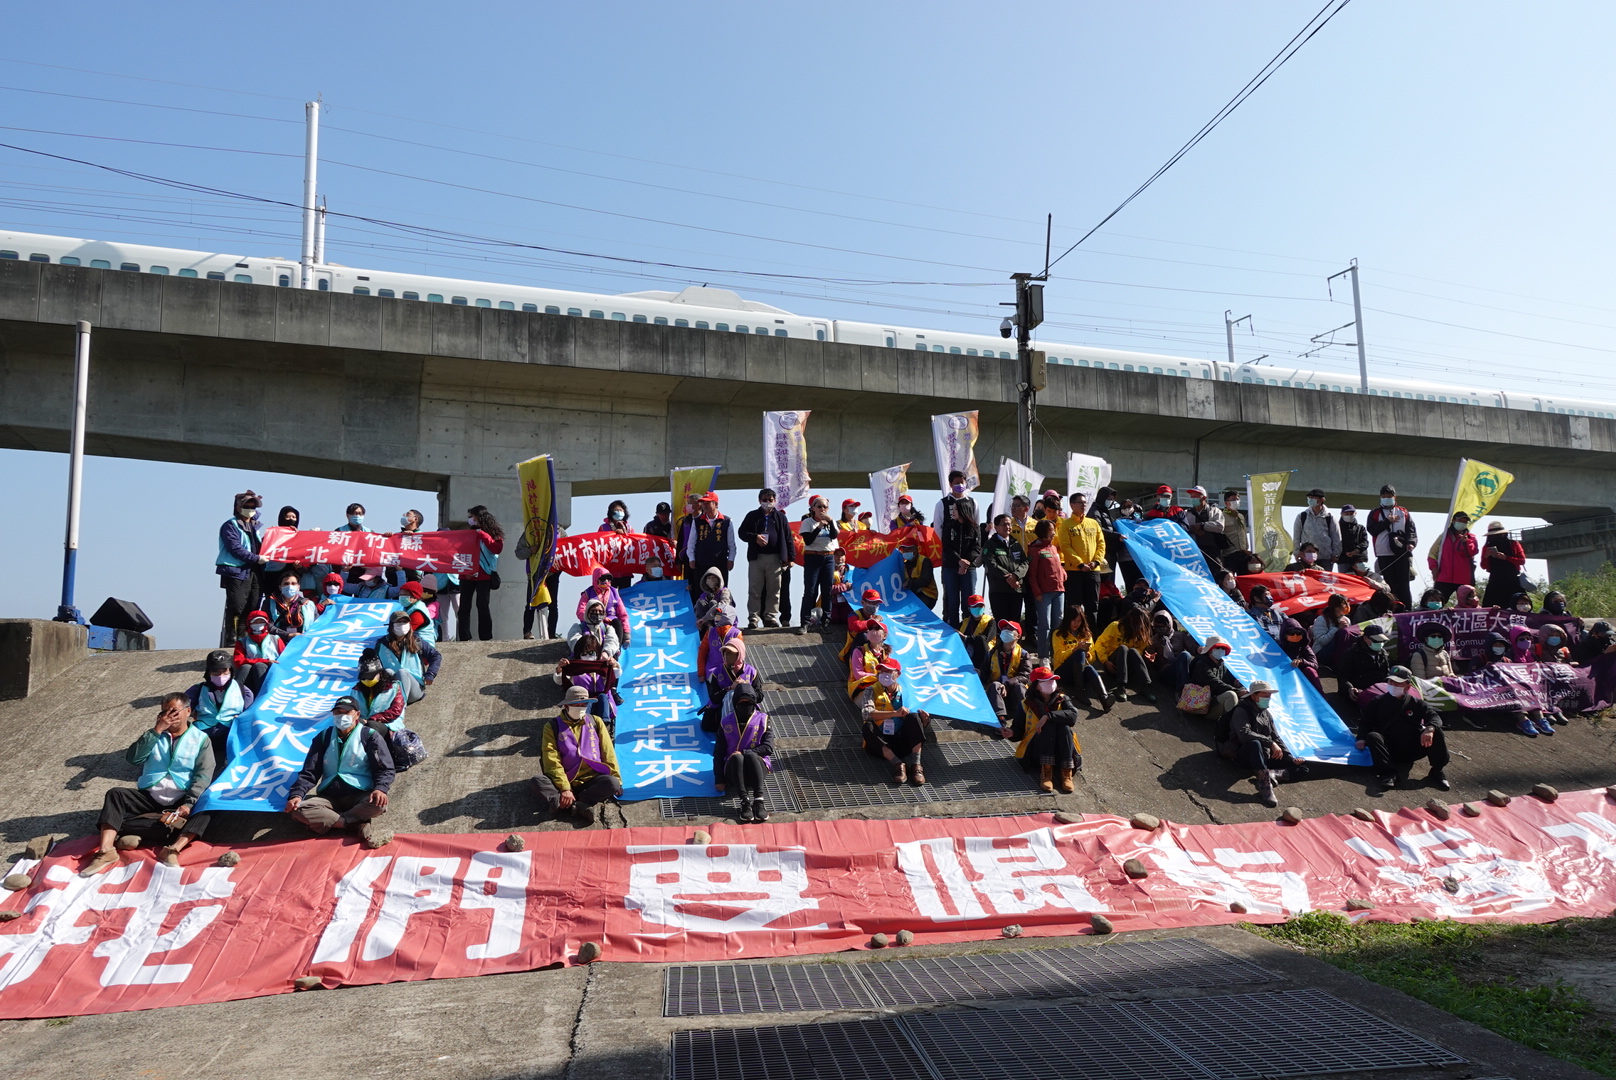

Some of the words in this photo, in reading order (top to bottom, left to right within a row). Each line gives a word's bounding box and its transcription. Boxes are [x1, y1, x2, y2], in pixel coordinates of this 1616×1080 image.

[327, 531, 424, 551] 新竹縣
[268, 545, 474, 573] 竹北社區大學
[209, 601, 394, 801] 四方匯流護水源
[629, 592, 705, 789] 新竹水網守起來
[1465, 694, 1492, 706] Green
[1492, 689, 1514, 702] Pine
